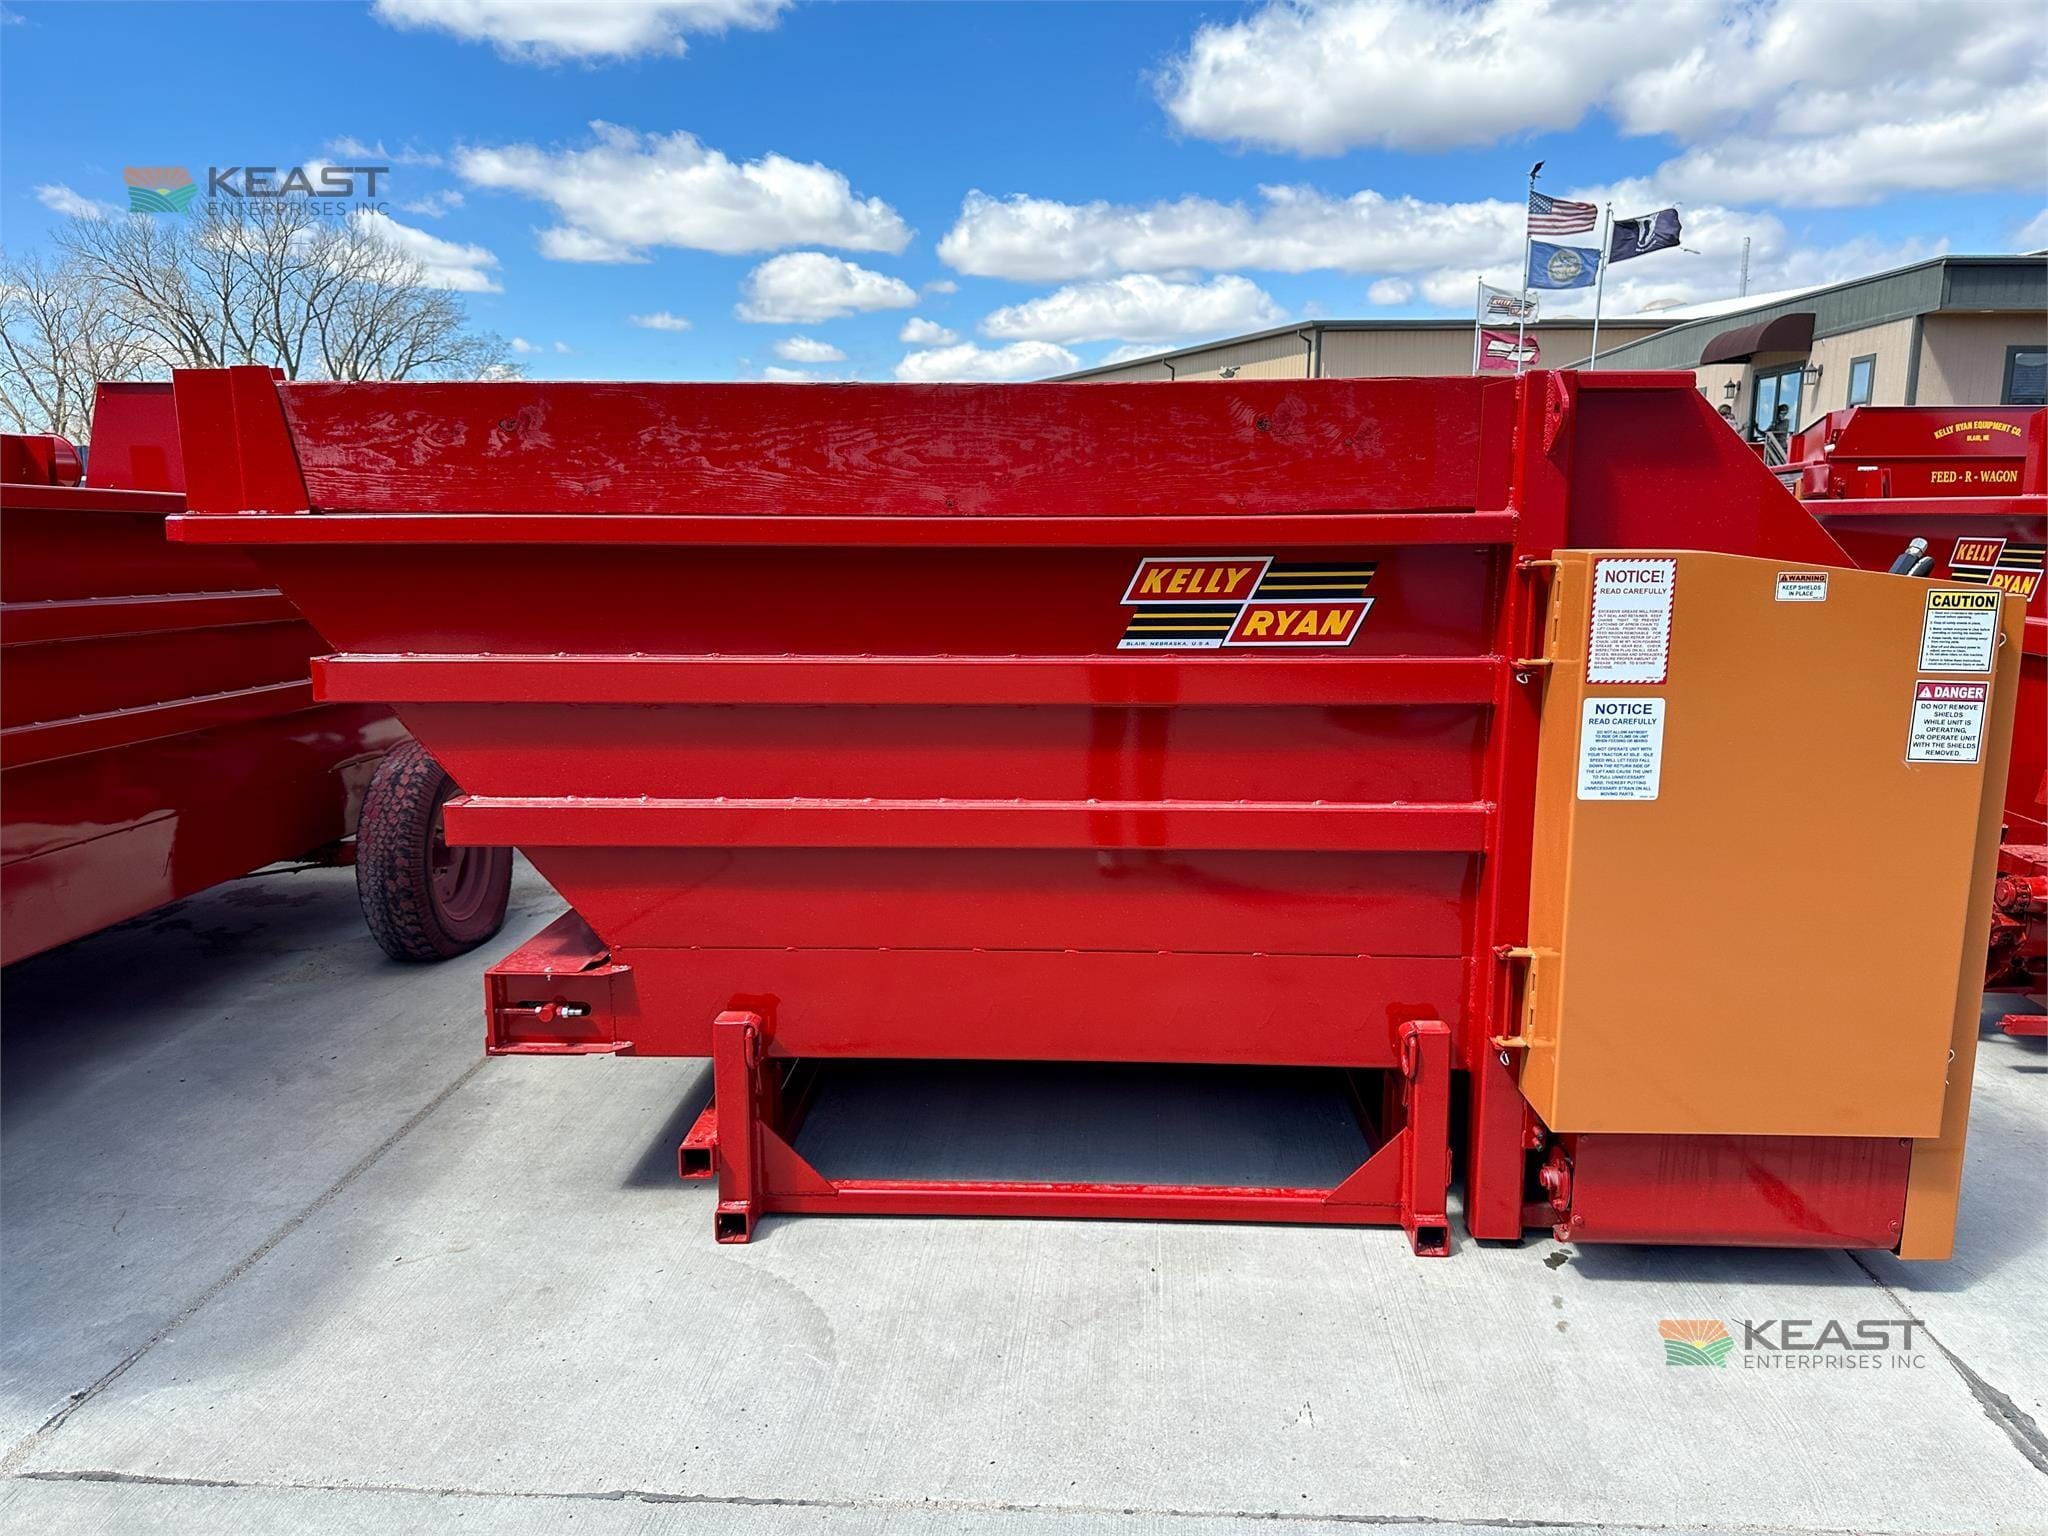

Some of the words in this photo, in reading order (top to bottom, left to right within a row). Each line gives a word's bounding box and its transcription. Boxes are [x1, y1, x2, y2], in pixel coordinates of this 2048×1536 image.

[1934, 425, 1954, 440] KELLY
[1955, 422, 1972, 432] RYAN
[1974, 420, 2010, 432] EQUIPMENT
[2010, 426, 2022, 437] CO.
[1931, 470, 1957, 482] FEED
[1965, 470, 1972, 482] R
[1980, 470, 2018, 482] WAGON
[1956, 544, 1998, 562] KELLY
[1140, 568, 1252, 593] KELLY
[1605, 570, 1665, 583] NOTICE!
[1992, 574, 2035, 594] RYAN
[1932, 595, 1995, 607] CAUTION
[1242, 610, 1354, 636] RYAN
[1934, 686, 1984, 698] DANGER
[1595, 704, 1652, 715] NOTICE
